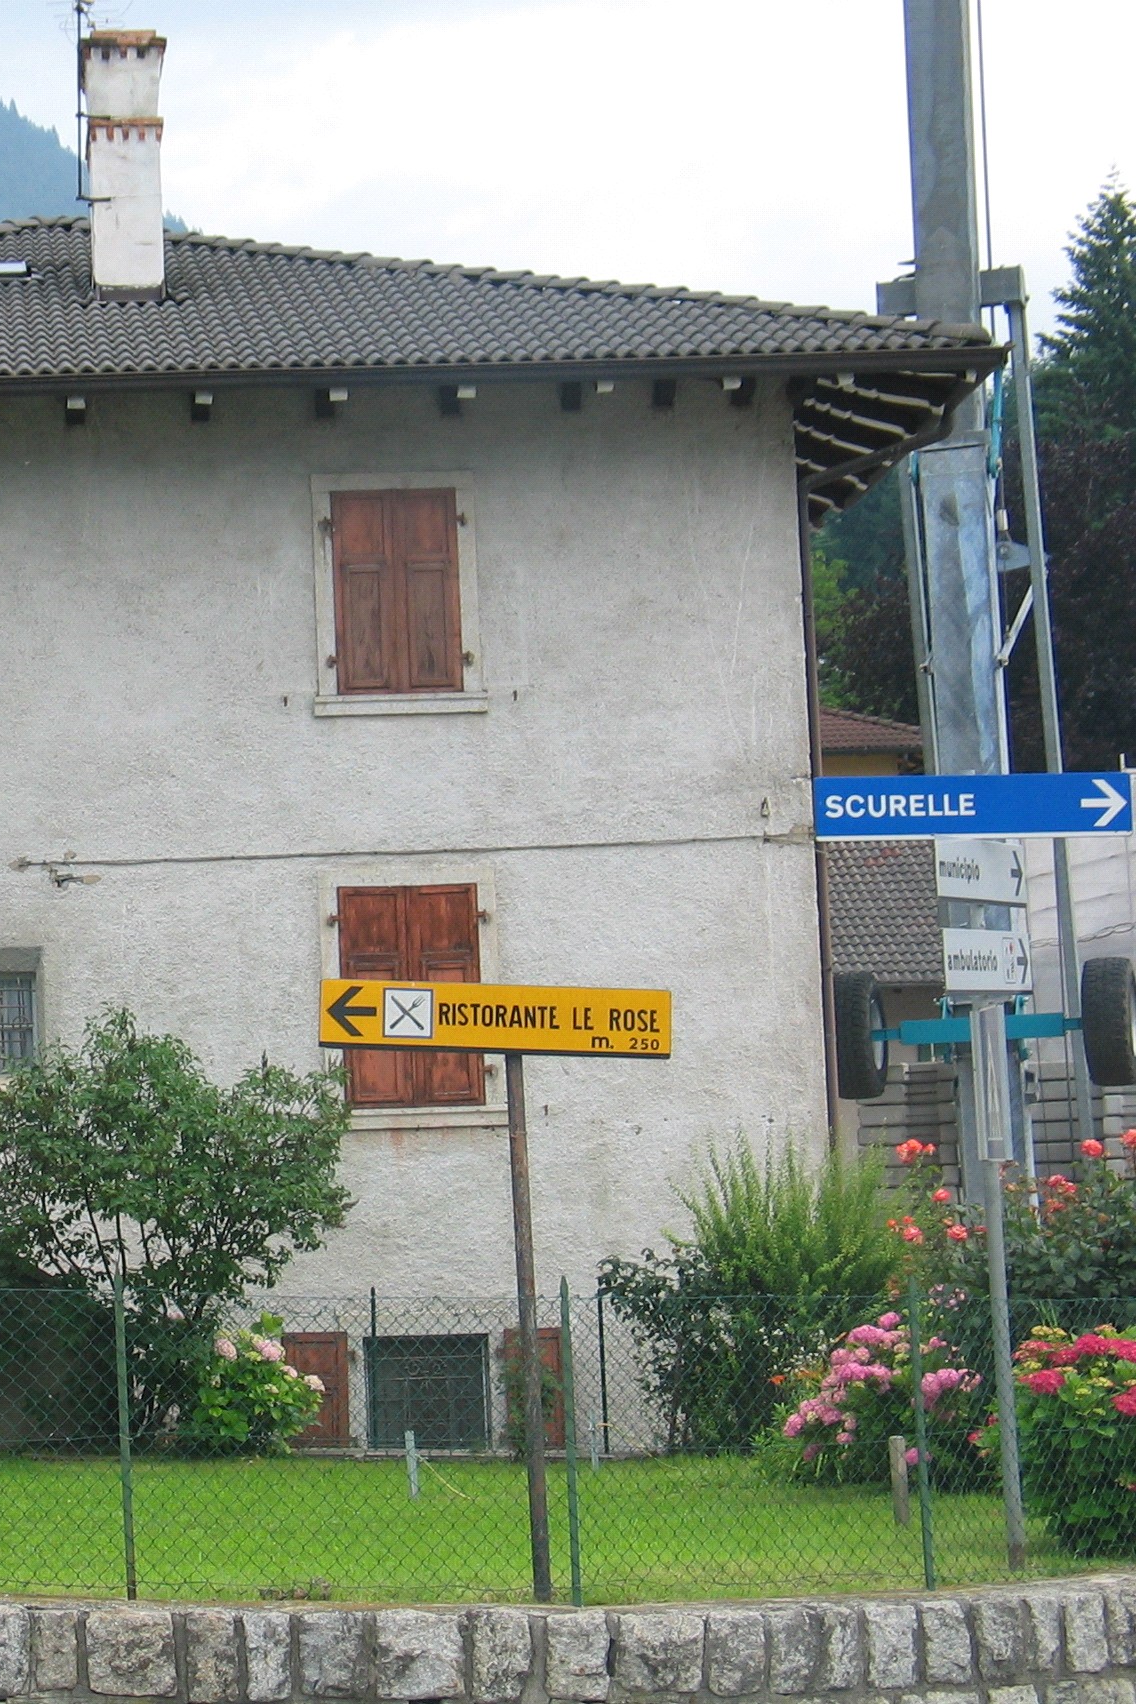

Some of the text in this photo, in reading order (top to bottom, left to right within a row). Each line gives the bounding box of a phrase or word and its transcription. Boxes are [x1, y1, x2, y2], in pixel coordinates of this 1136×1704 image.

[825, 794, 976, 818] SCURELLE
[939, 856, 980, 884] municipio
[947, 949, 998, 972] ambulatorio
[438, 1002, 660, 1033] RISTORANTE LE ROSE
[591, 1036, 660, 1050] m. 250
